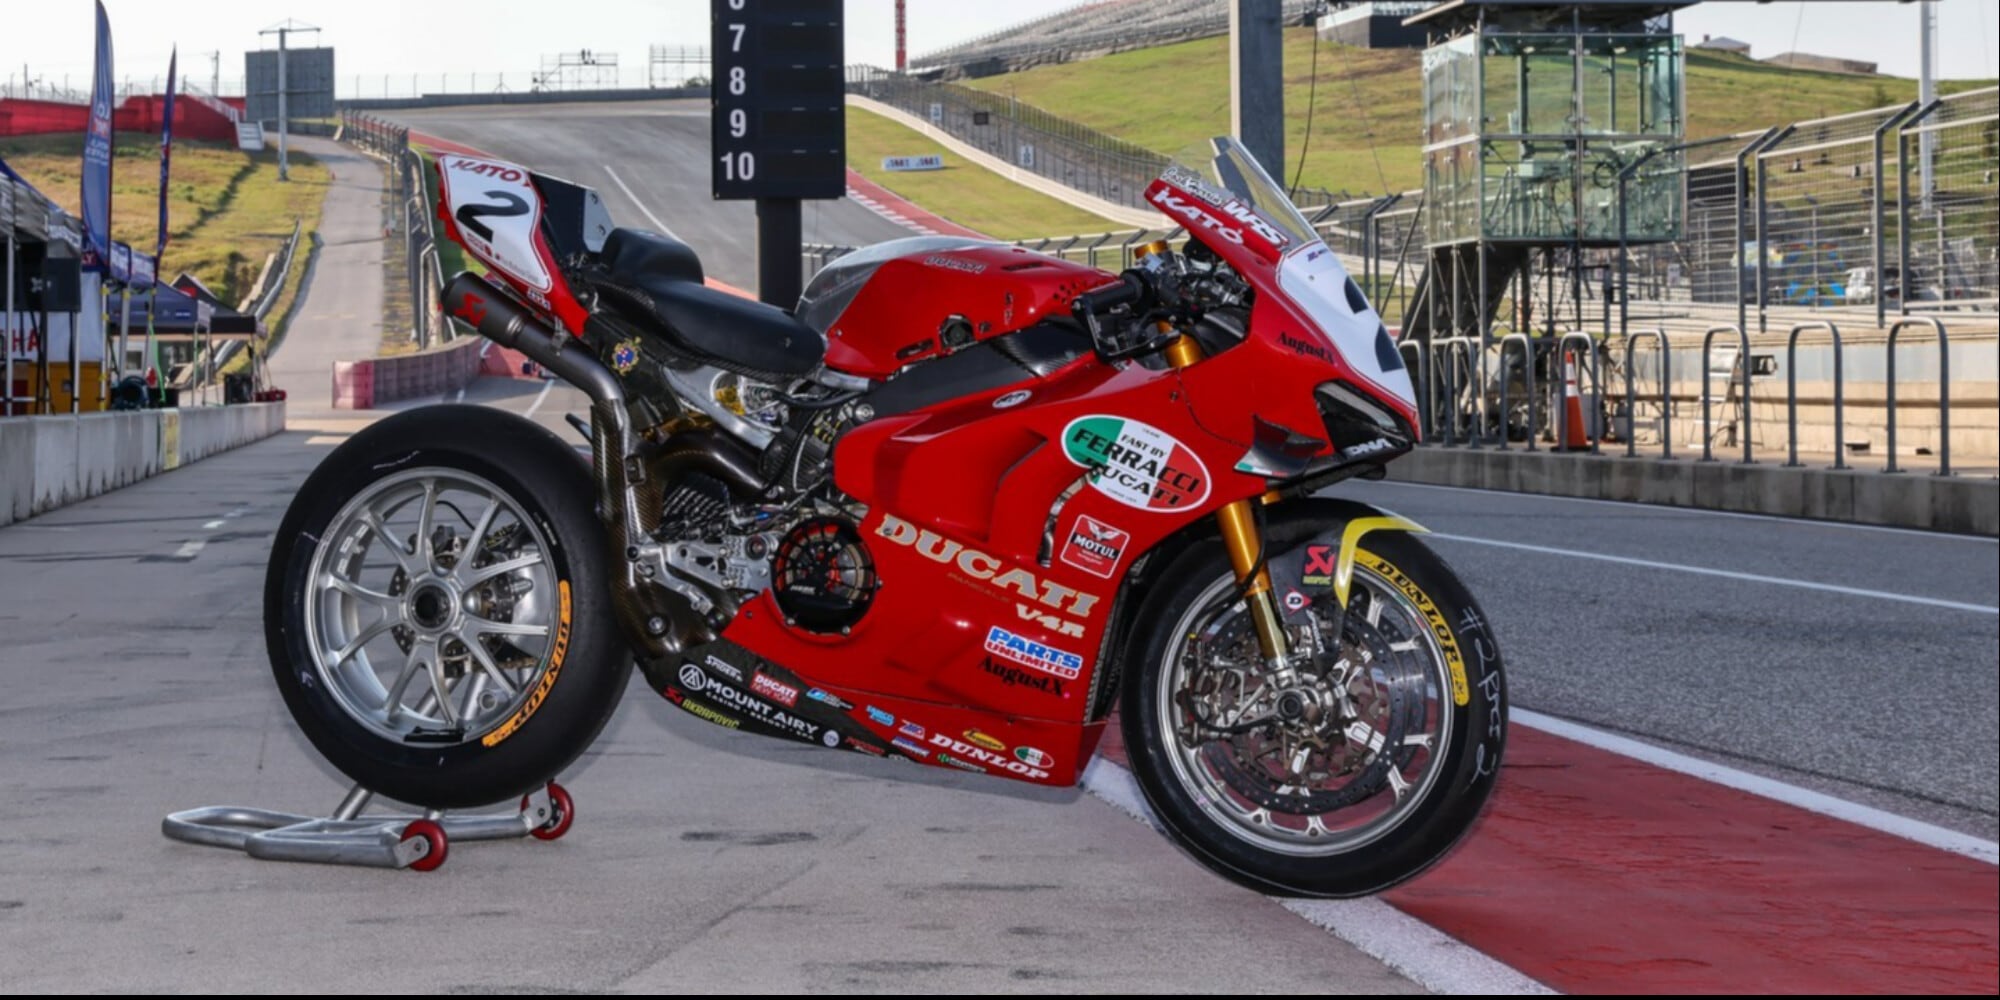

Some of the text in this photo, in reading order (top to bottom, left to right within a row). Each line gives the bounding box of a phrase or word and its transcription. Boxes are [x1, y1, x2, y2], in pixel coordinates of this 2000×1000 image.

[729, 24, 746, 52] 7
[729, 66, 746, 95] 8
[729, 109, 746, 138] 9
[720, 152, 755, 181] 10
[456, 190, 530, 243] 2
[1153, 187, 1244, 244] KATO
[1223, 201, 1289, 245] WRS
[924, 256, 987, 274] DUCATI
[1072, 429, 1200, 493] FERRACCI
[1120, 434, 1168, 458] FAST BY
[874, 513, 1100, 617] DUCATI
[1073, 534, 1117, 559] MOTUL
[1016, 603, 1085, 639] V4R
[1374, 560, 1459, 664] DUNLOP
[987, 641, 1077, 677] UNLIMITED
[989, 628, 1081, 669] PARTS
[754, 674, 798, 699] DUCATI
[978, 655, 1066, 697] AugustX
[707, 677, 819, 734] MOUNT AIRY
[929, 733, 1049, 778] DUNLOP
